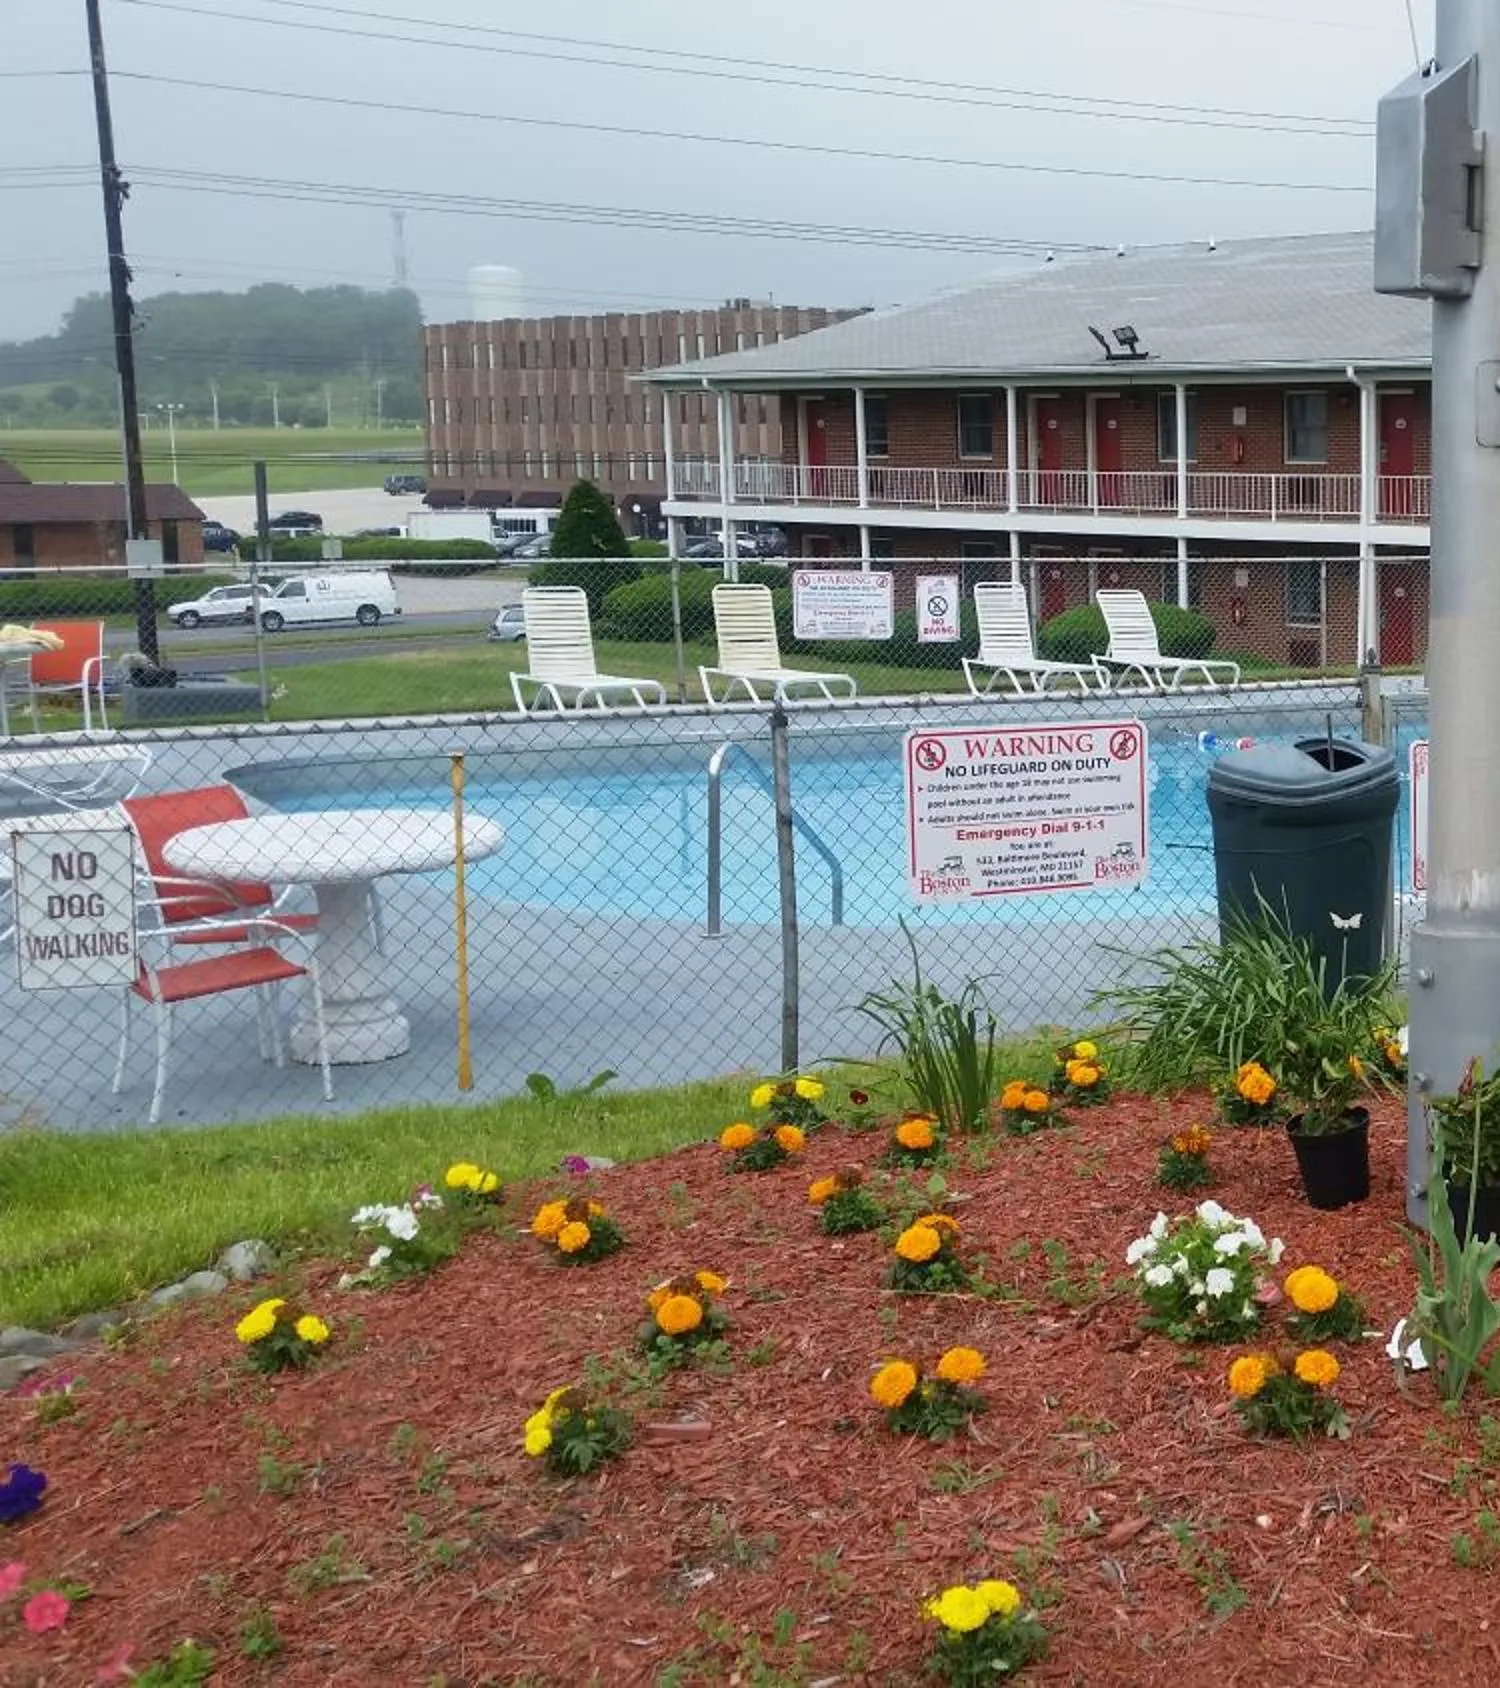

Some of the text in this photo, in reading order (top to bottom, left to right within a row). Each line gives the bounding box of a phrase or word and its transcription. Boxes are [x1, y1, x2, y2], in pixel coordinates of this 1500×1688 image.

[931, 618, 945, 626] NO
[964, 734, 1093, 758] WARNING
[945, 757, 1111, 778] NO LIFEGUARD ON DUTY
[927, 783, 962, 793] Children
[964, 781, 988, 791] under
[989, 780, 1004, 789] the
[1006, 780, 1020, 789] age
[1034, 778, 1051, 787] may
[1052, 777, 1065, 785] not
[927, 799, 946, 810] pool
[948, 796, 980, 807] without
[995, 794, 1016, 804] adult
[1018, 793, 1025, 802] in
[928, 815, 954, 824] Adults
[957, 812, 984, 822] should
[986, 811, 1000, 820] not
[1052, 807, 1072, 815] Swim
[957, 819, 1105, 841] Emergency Dial 9-1-1
[51, 851, 98, 881] NO
[998, 852, 1041, 863] Baltimore
[1040, 863, 1057, 871] MD
[1095, 861, 1141, 879] Boston
[920, 875, 971, 895] Boston
[47, 893, 105, 919] DOG
[25, 931, 130, 961] WALKING
